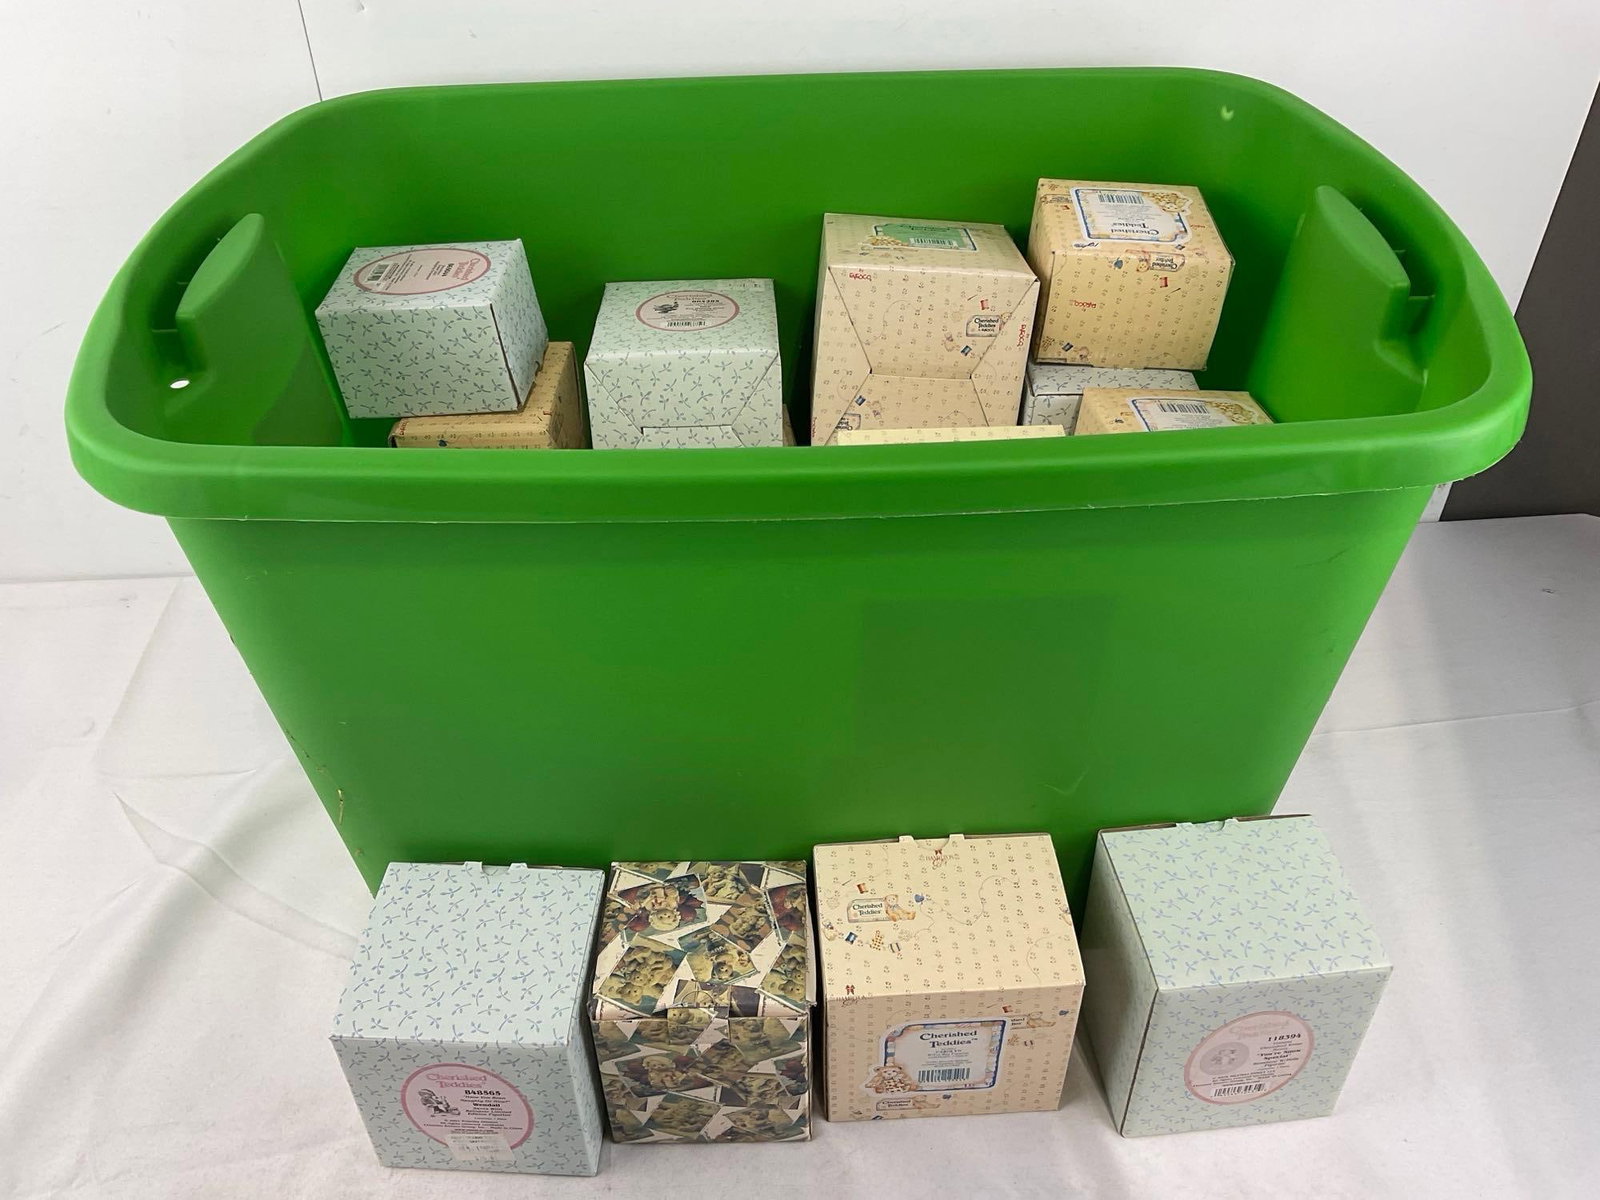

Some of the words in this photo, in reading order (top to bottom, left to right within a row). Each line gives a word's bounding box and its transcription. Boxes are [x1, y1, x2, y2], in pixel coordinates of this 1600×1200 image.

[1110, 228, 1160, 236] Cherished
[1151, 261, 1178, 270] Cherished
[852, 902, 883, 910] Cherished
[919, 1030, 977, 1041] Cherished
[1267, 1033, 1302, 1042] 118394
[426, 1073, 488, 1081] Cherished
